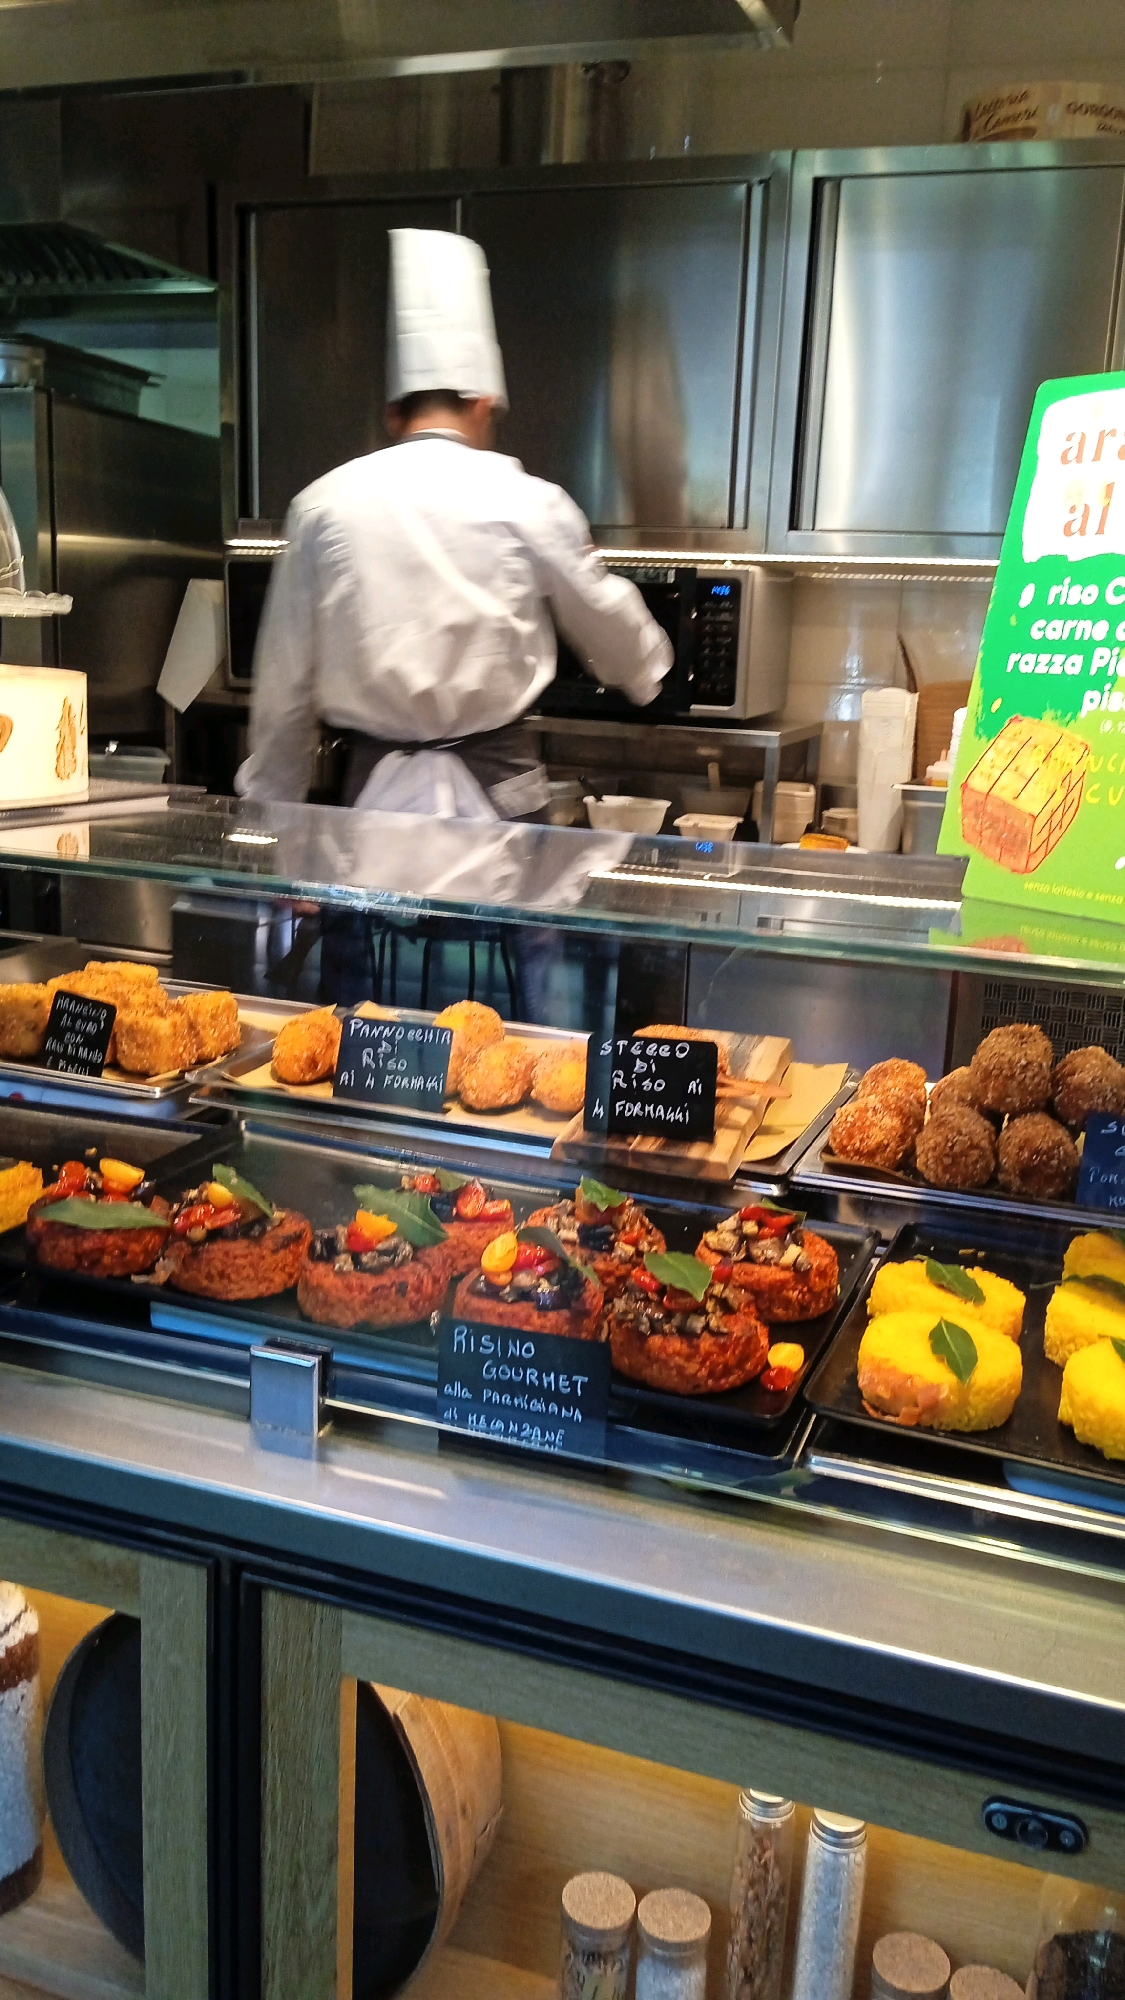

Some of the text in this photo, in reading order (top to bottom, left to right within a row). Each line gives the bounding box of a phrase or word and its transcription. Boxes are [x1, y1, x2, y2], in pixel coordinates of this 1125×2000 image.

[1047, 576, 1100, 606] riso
[1030, 619, 1110, 642] carne
[1006, 652, 1084, 676] razza
[443, 1380, 473, 1400] alla
[482, 1359, 589, 1397] GOURMET
